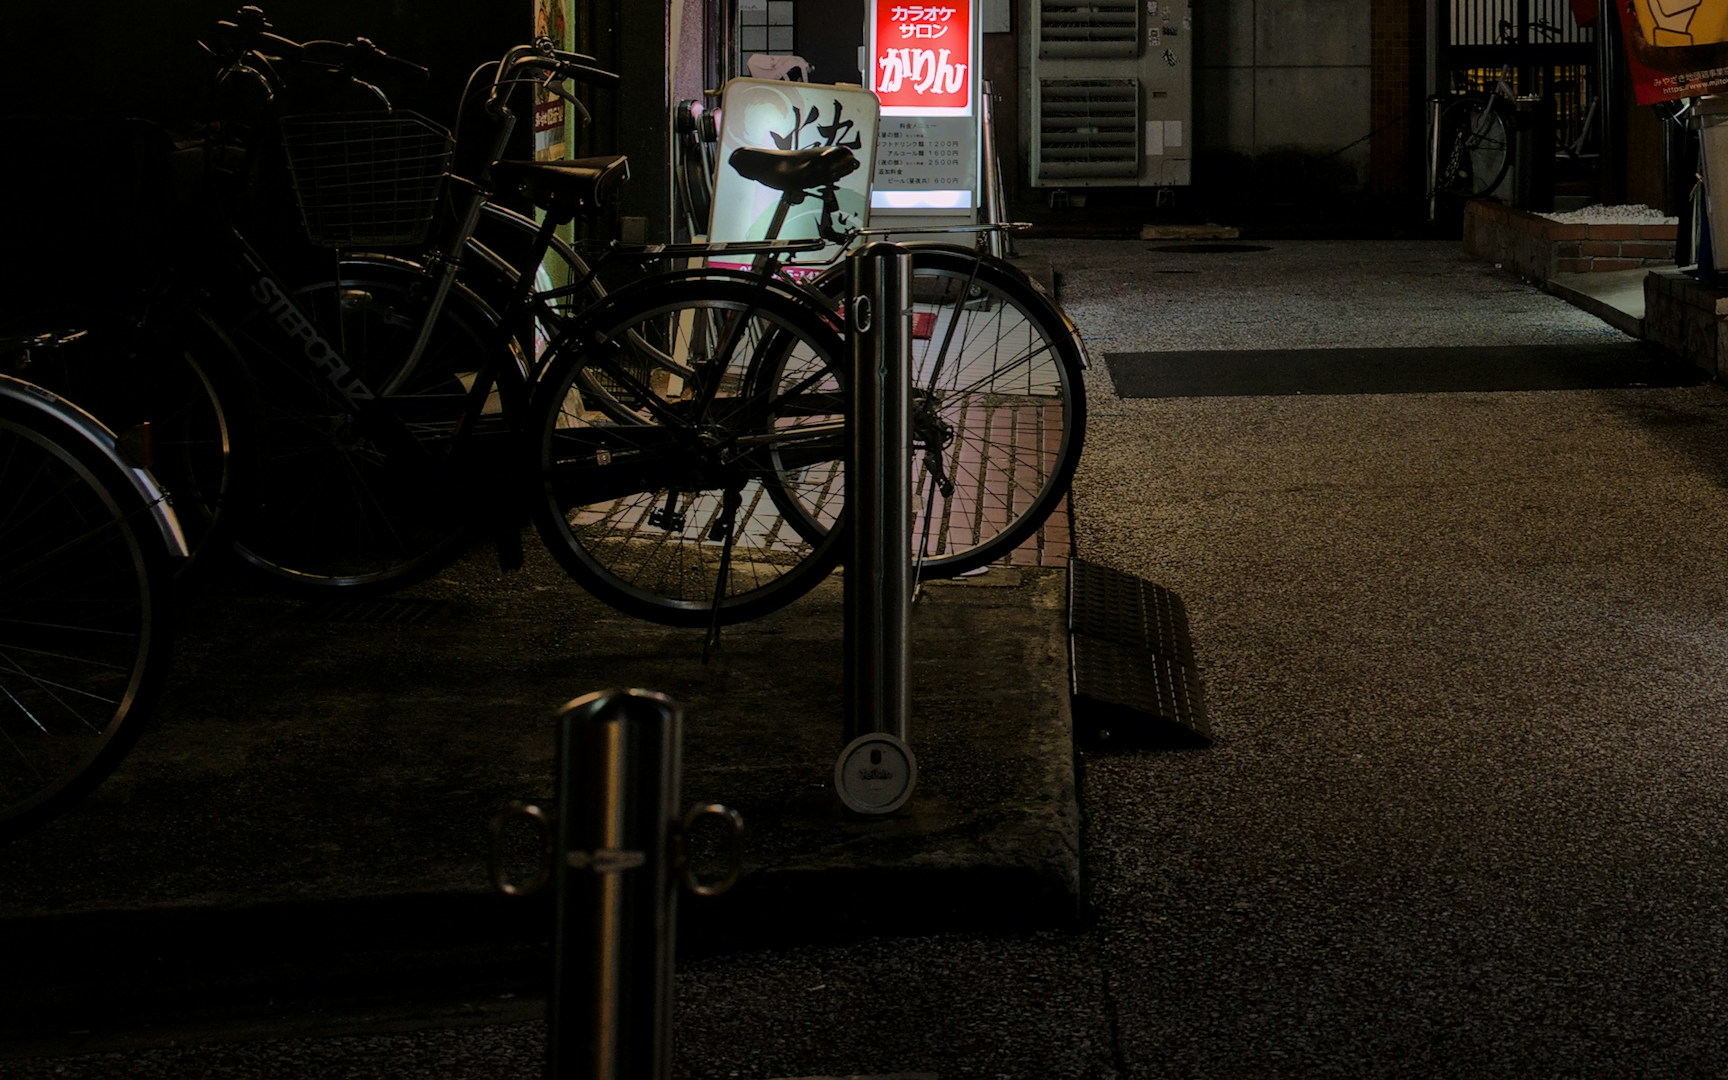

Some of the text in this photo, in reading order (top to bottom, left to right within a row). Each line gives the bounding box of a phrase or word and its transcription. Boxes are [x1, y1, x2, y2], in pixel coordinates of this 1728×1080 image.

[891, 6, 956, 21] カラオケ
[899, 23, 948, 38] サロン
[877, 48, 967, 94] かりん
